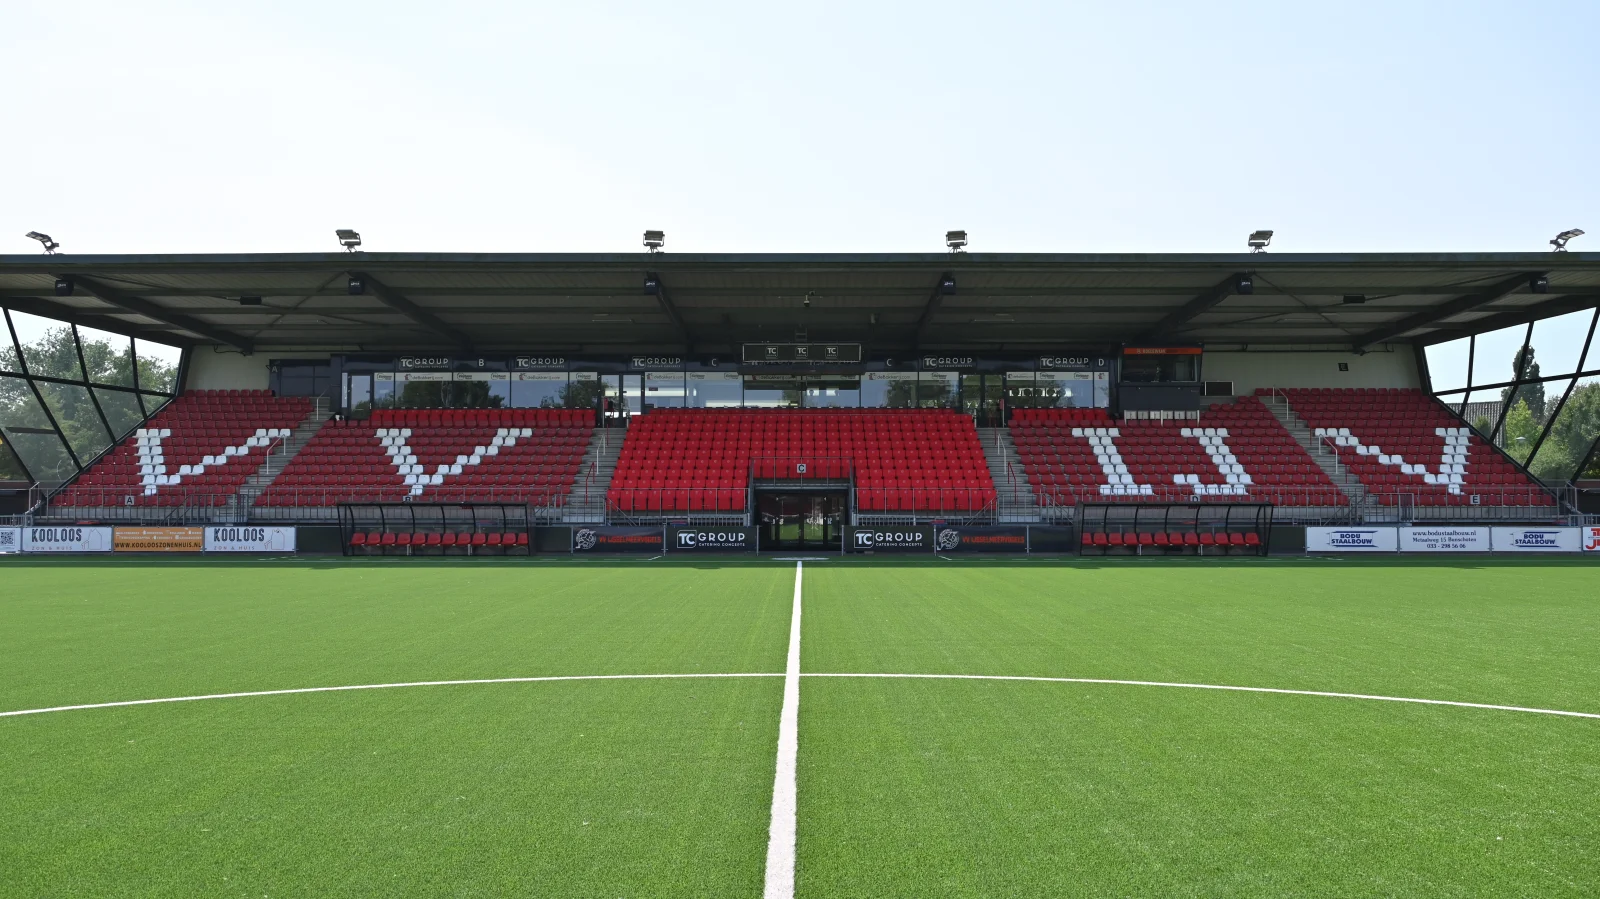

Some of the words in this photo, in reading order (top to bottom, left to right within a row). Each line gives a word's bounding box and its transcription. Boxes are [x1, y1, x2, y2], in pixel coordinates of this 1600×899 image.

[400, 358, 413, 367] TC
[478, 358, 485, 367] B
[516, 358, 529, 367] TC
[530, 357, 565, 365] GROUP
[632, 358, 645, 367] TC
[711, 358, 717, 367] C
[886, 358, 892, 367] C
[924, 358, 937, 366] TC
[1040, 358, 1053, 366] TC
[1098, 358, 1105, 367] D
[798, 464, 805, 472] C
[126, 496, 133, 504] A
[1472, 496, 1479, 504] E
[31, 528, 82, 543] KOOLOOS
[213, 527, 265, 542] KOOLOOS
[678, 533, 695, 545] TC
[698, 532, 746, 541] GROUP
[855, 533, 873, 545] TC
[875, 532, 923, 541] GROUP
